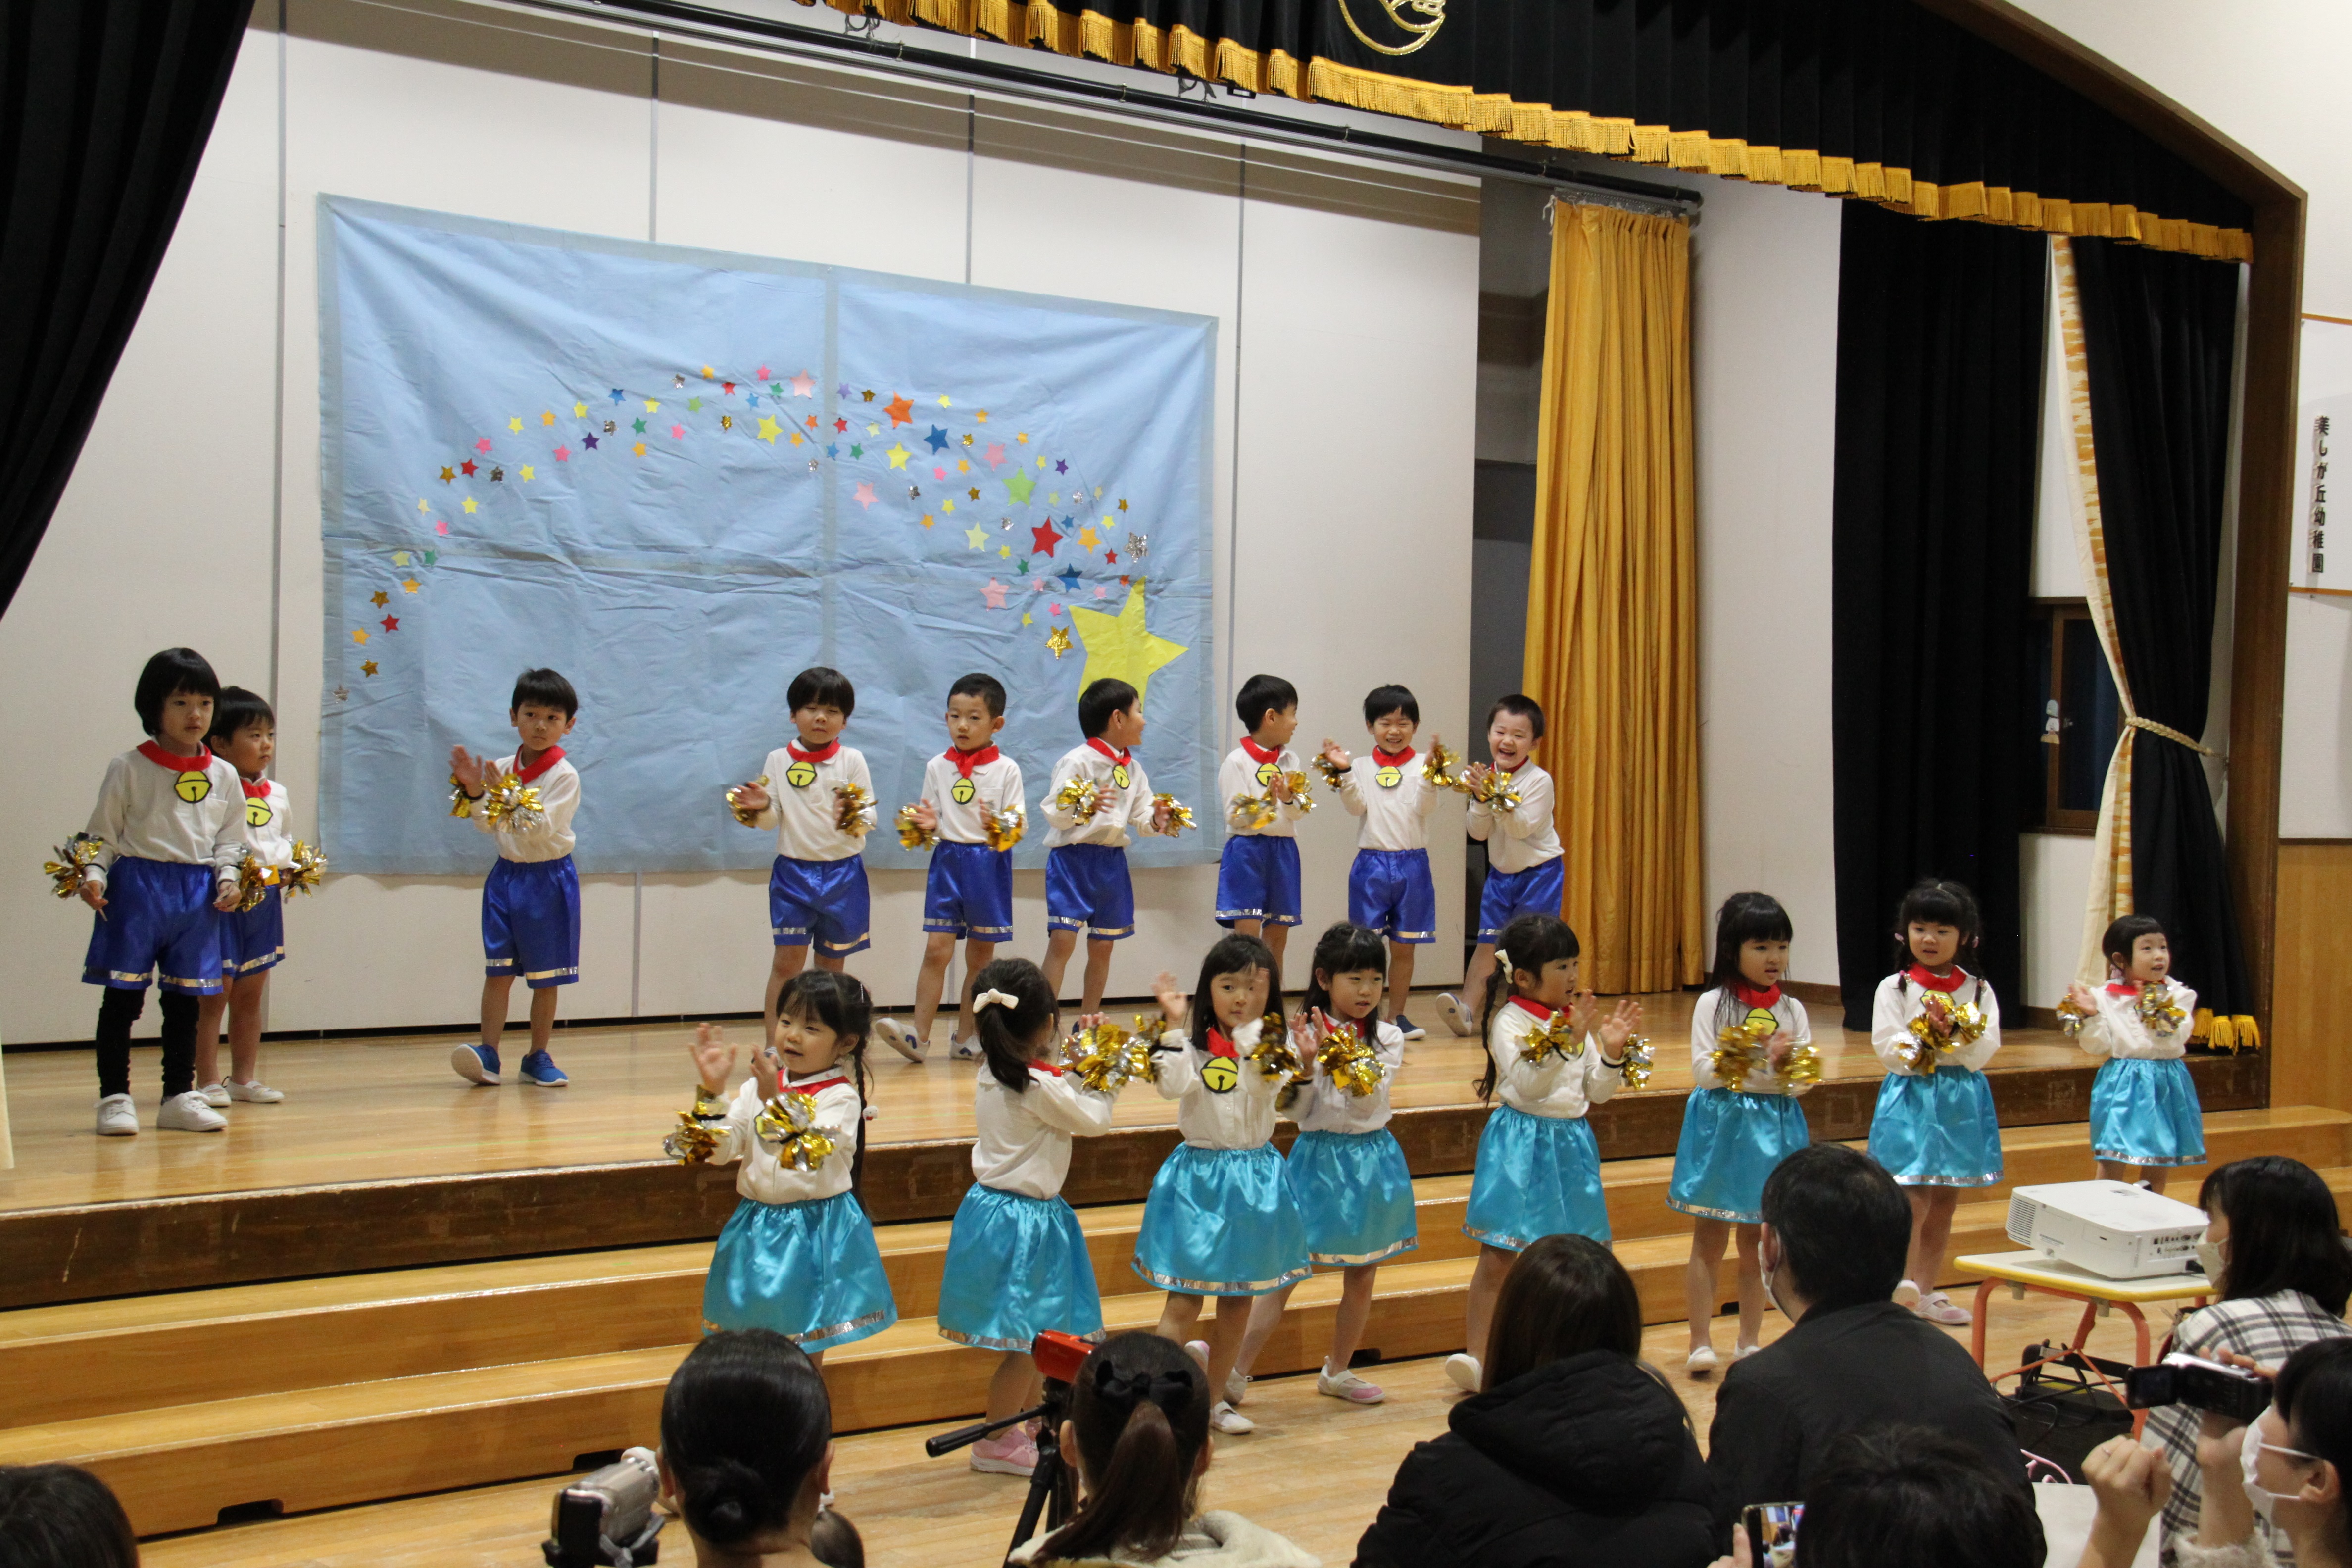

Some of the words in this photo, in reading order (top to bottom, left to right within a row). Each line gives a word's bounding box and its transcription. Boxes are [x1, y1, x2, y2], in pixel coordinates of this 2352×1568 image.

[2311, 415, 2330, 573] 美しが丘幼稚園
